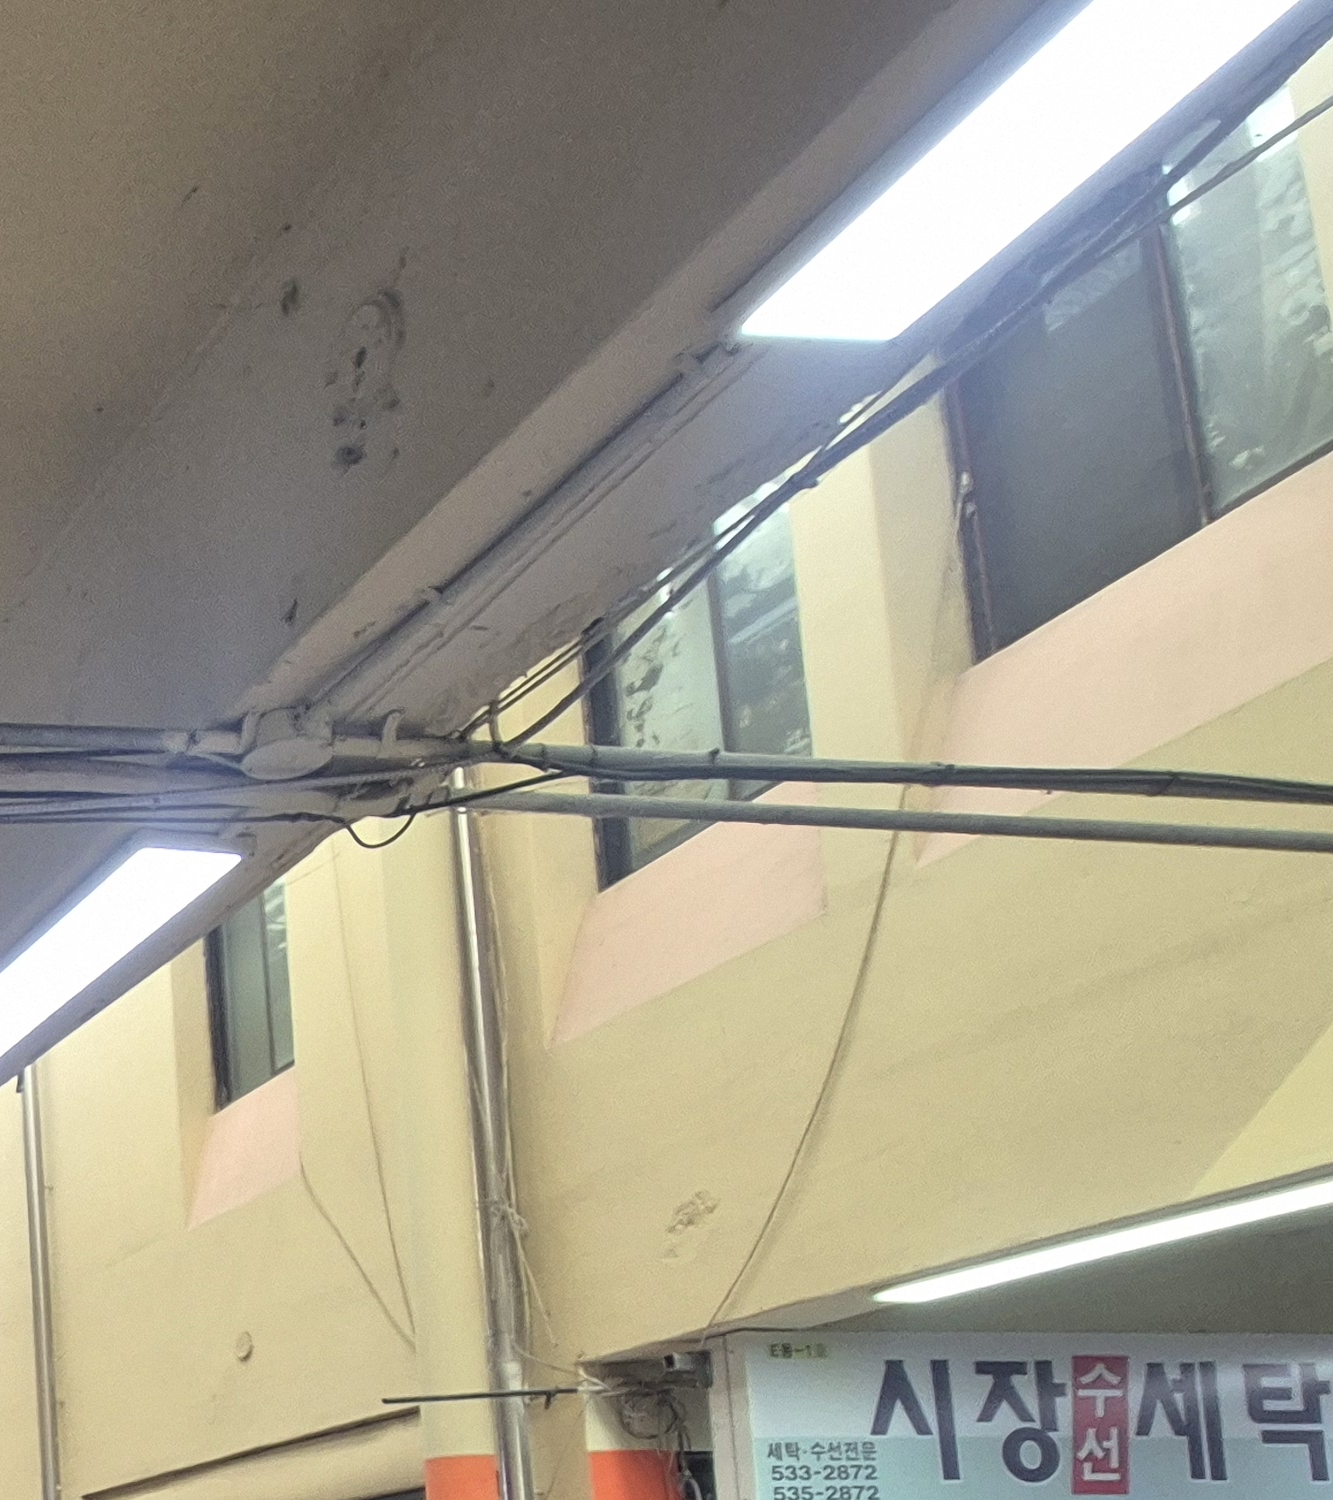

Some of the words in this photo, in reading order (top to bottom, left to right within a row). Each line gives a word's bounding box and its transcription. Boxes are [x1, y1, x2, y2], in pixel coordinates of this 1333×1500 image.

[771, 1465, 878, 1481] 533-2872
[870, 1359, 1067, 1483] 시장
[1076, 1362, 1124, 1482] 수선
[1135, 1360, 1331, 1482] 세탁
[773, 1485, 880, 1500] 535-2872
